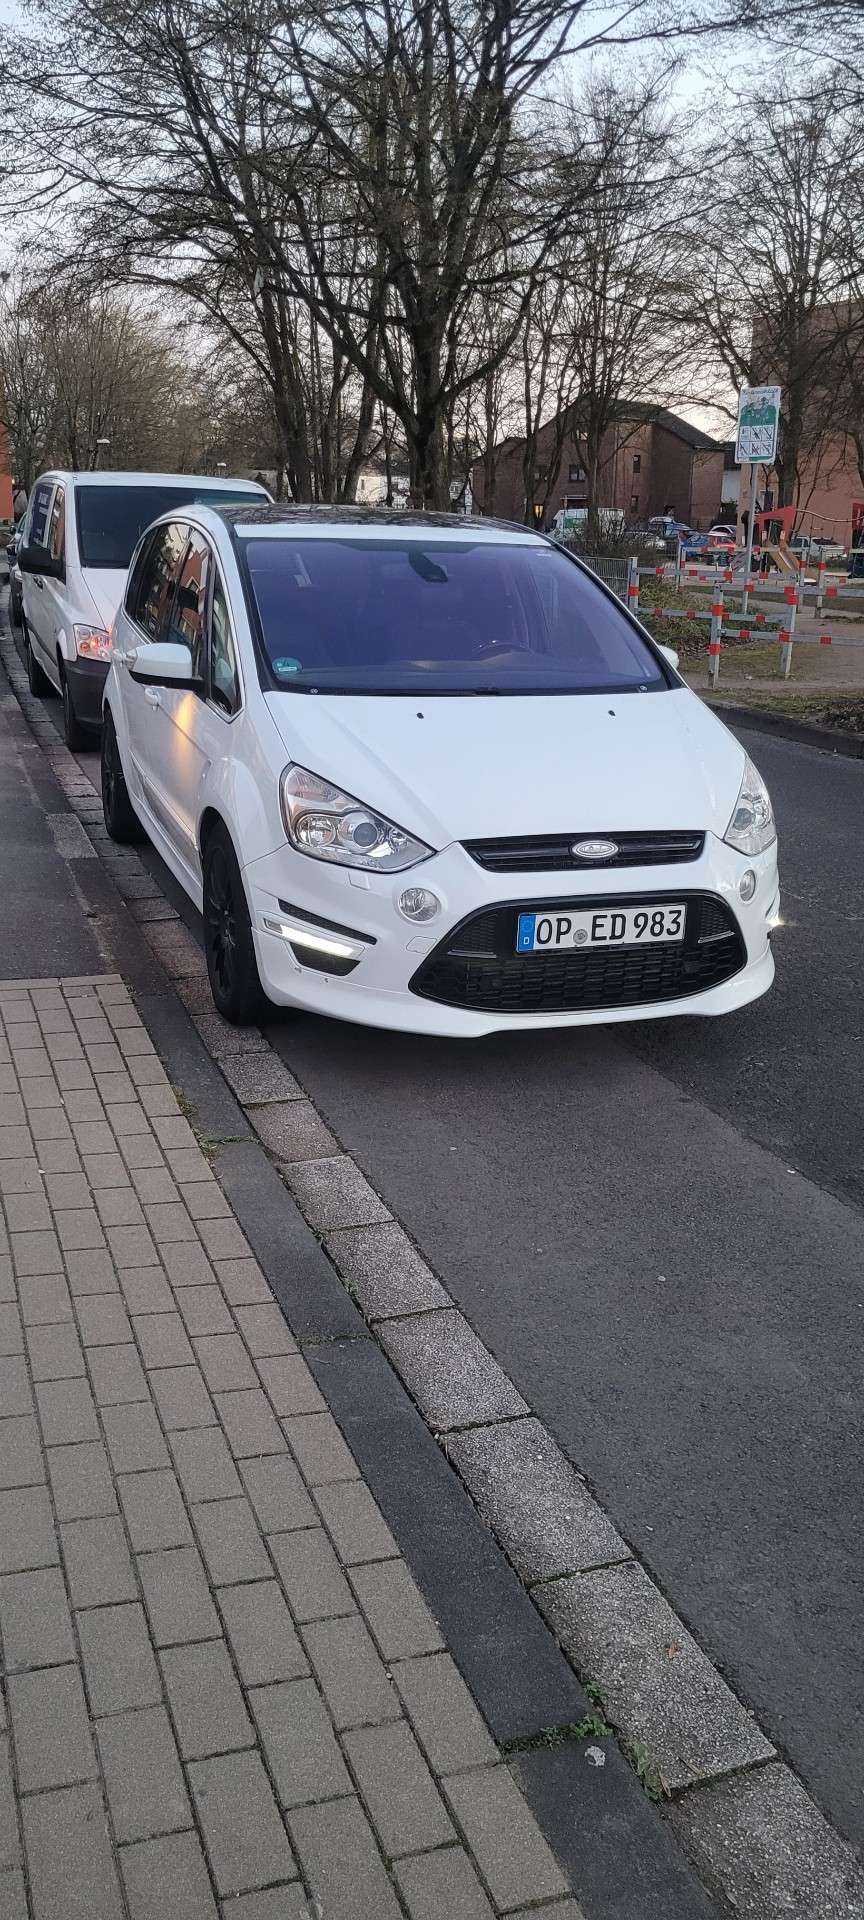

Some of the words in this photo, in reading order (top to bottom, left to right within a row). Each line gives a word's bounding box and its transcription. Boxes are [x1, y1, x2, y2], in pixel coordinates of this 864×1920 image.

[536, 917, 572, 945] OP
[591, 913, 627, 941] ED
[633, 909, 682, 938] 983
